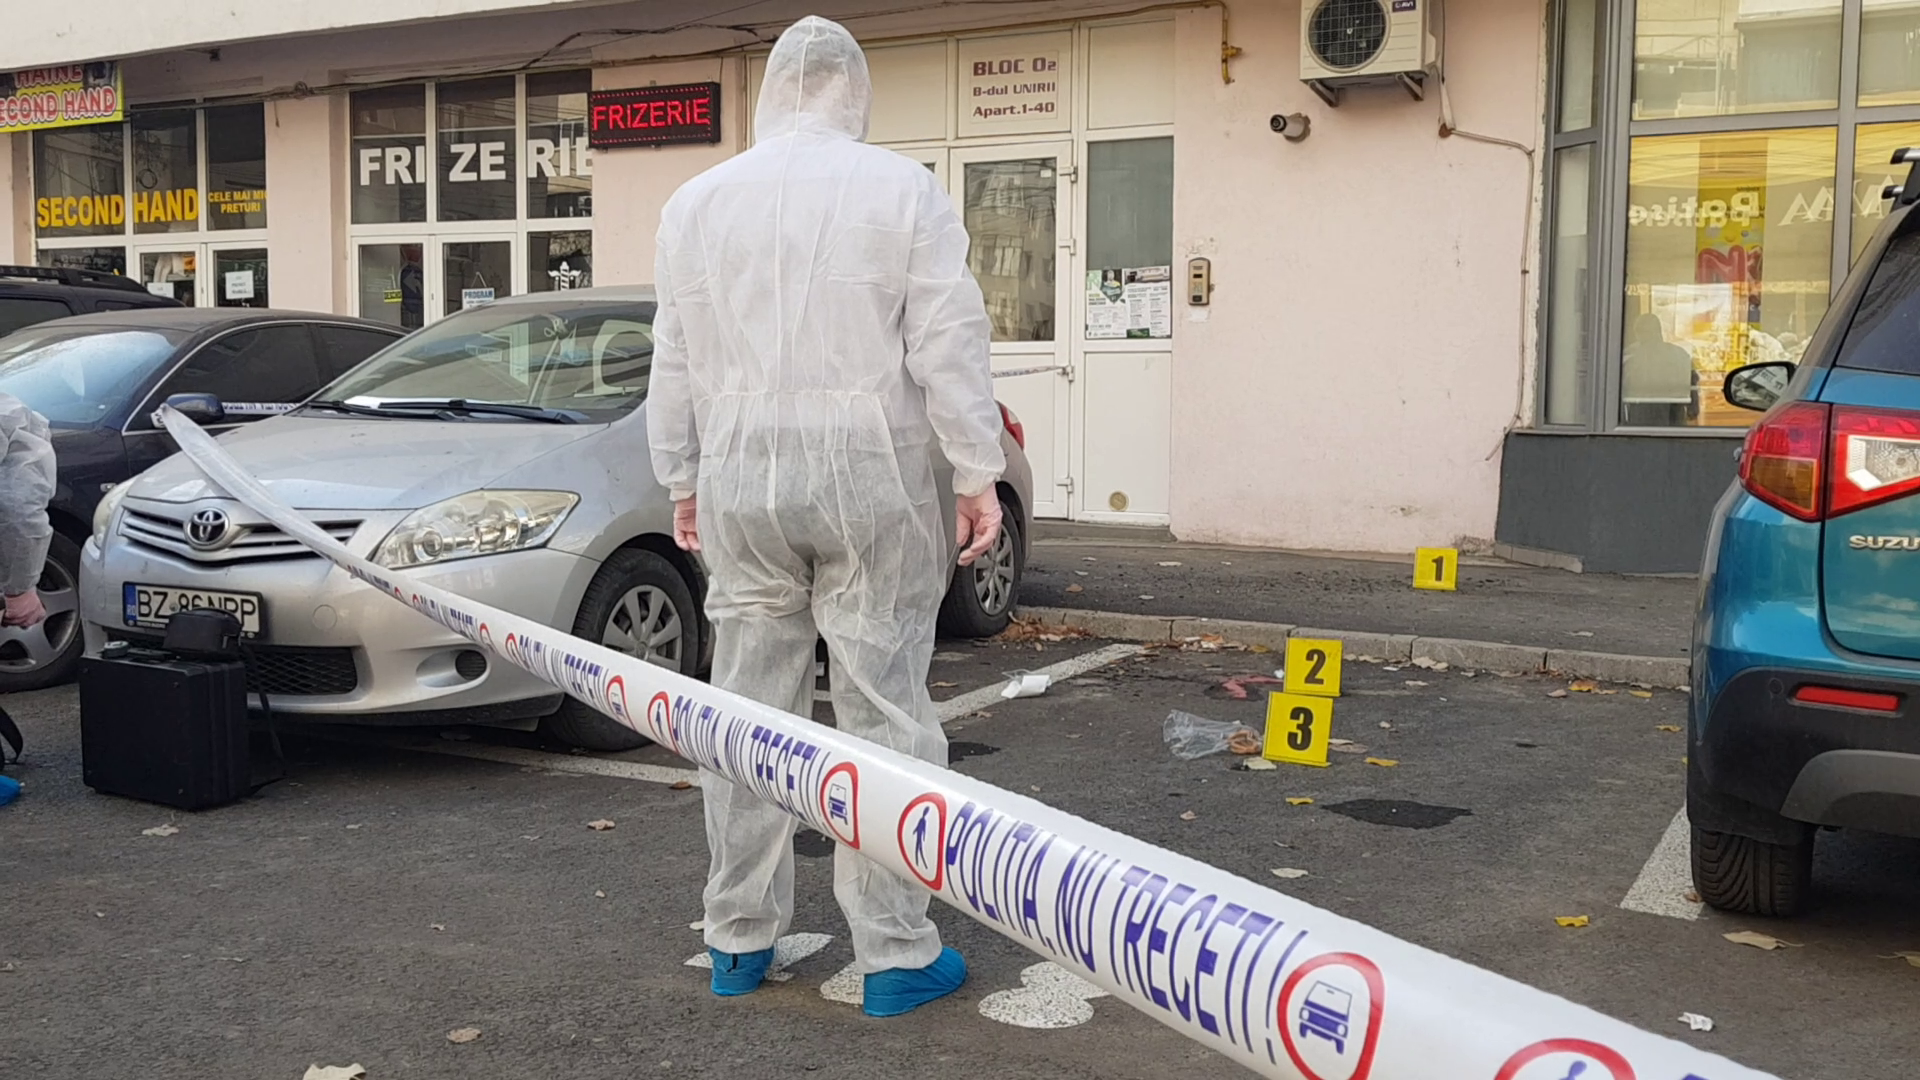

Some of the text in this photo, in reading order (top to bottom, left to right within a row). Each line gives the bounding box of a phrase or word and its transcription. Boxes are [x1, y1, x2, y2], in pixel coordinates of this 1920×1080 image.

[973, 58, 1025, 76] BLOC
[62, 86, 117, 121] HAND
[973, 81, 1056, 97] B-dul UNIRII
[593, 97, 710, 131] FRIZERIE
[37, 188, 199, 228] SECOND HAND
[208, 191, 231, 203] CELE
[233, 190, 251, 201] MAI
[221, 202, 261, 214] PRETURI
[1431, 555, 1445, 582] 1
[137, 589, 169, 618] BZ
[1303, 648, 1327, 685] 2
[1286, 706, 1314, 751] 3
[1055, 844, 1122, 973] NU
